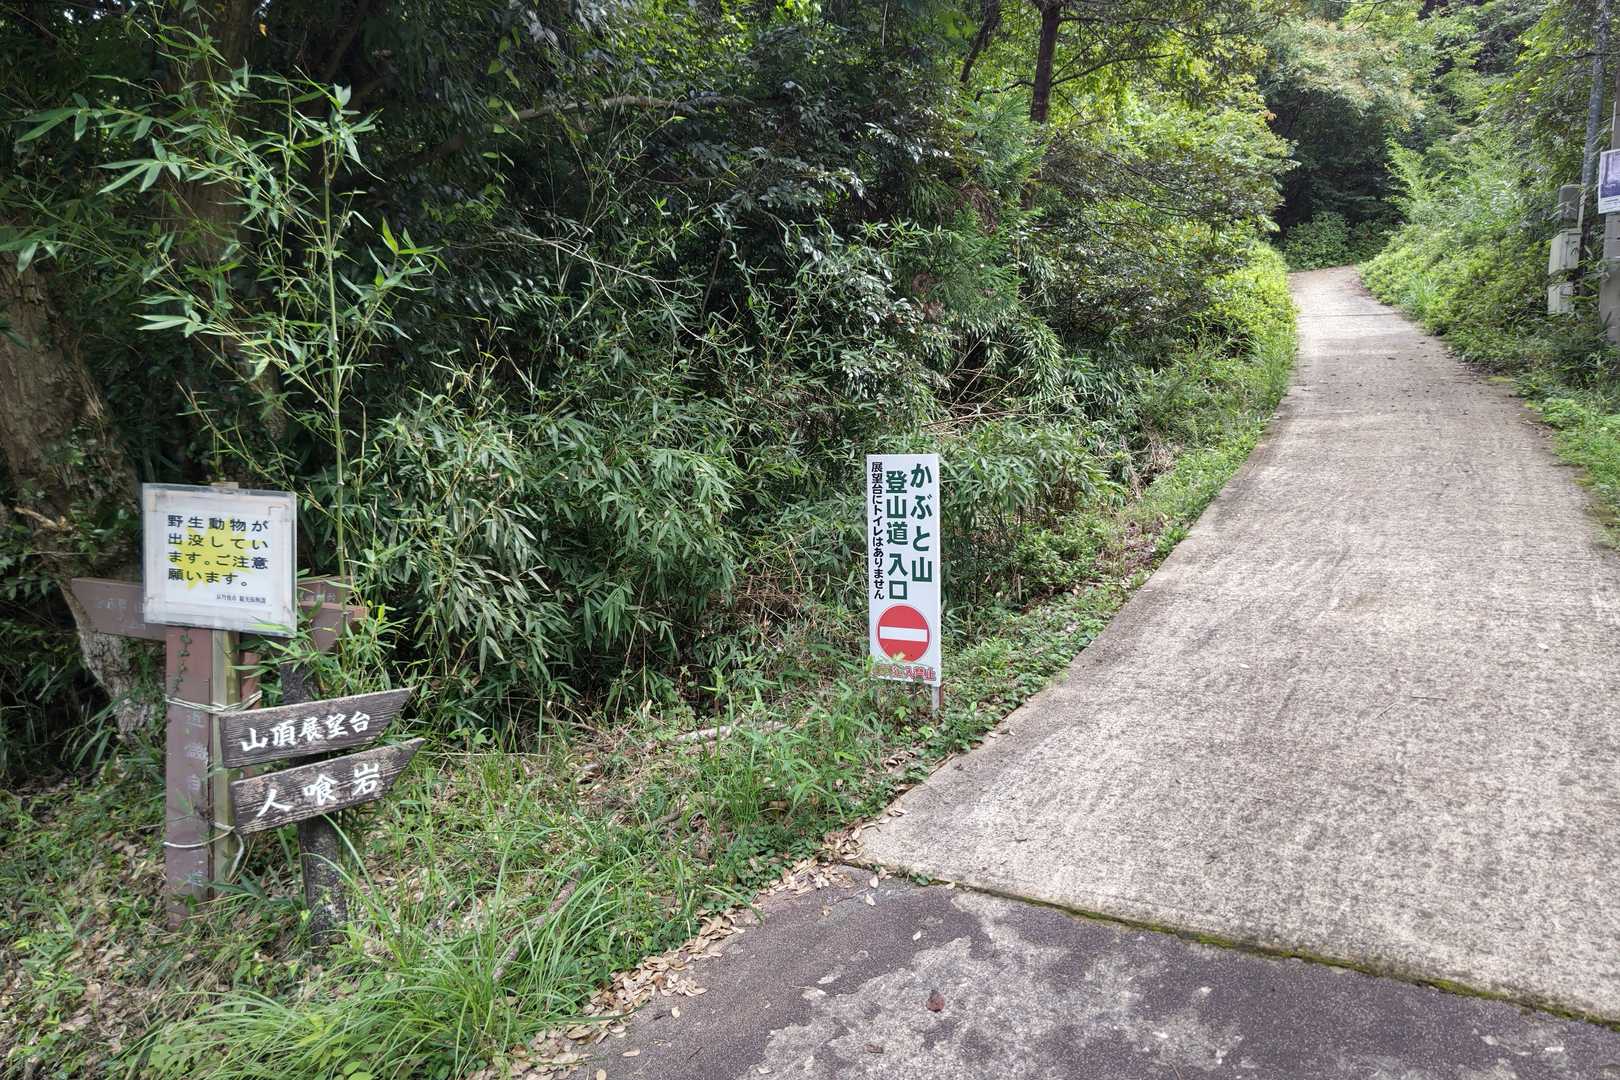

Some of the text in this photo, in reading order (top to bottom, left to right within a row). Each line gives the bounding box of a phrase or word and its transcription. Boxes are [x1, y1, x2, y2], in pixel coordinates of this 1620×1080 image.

[168, 514, 269, 532] 野生動物が
[168, 533, 268, 550] 出没してい
[871, 461, 884, 600] 展望台にトイレはありません
[886, 470, 908, 600] 登山道入口
[910, 463, 933, 582] かぶと山
[168, 551, 268, 570] ます。ご注意
[168, 567, 247, 586] 願います。
[240, 711, 371, 752] 山頂展望台
[256, 763, 380, 818] 人喰岩
